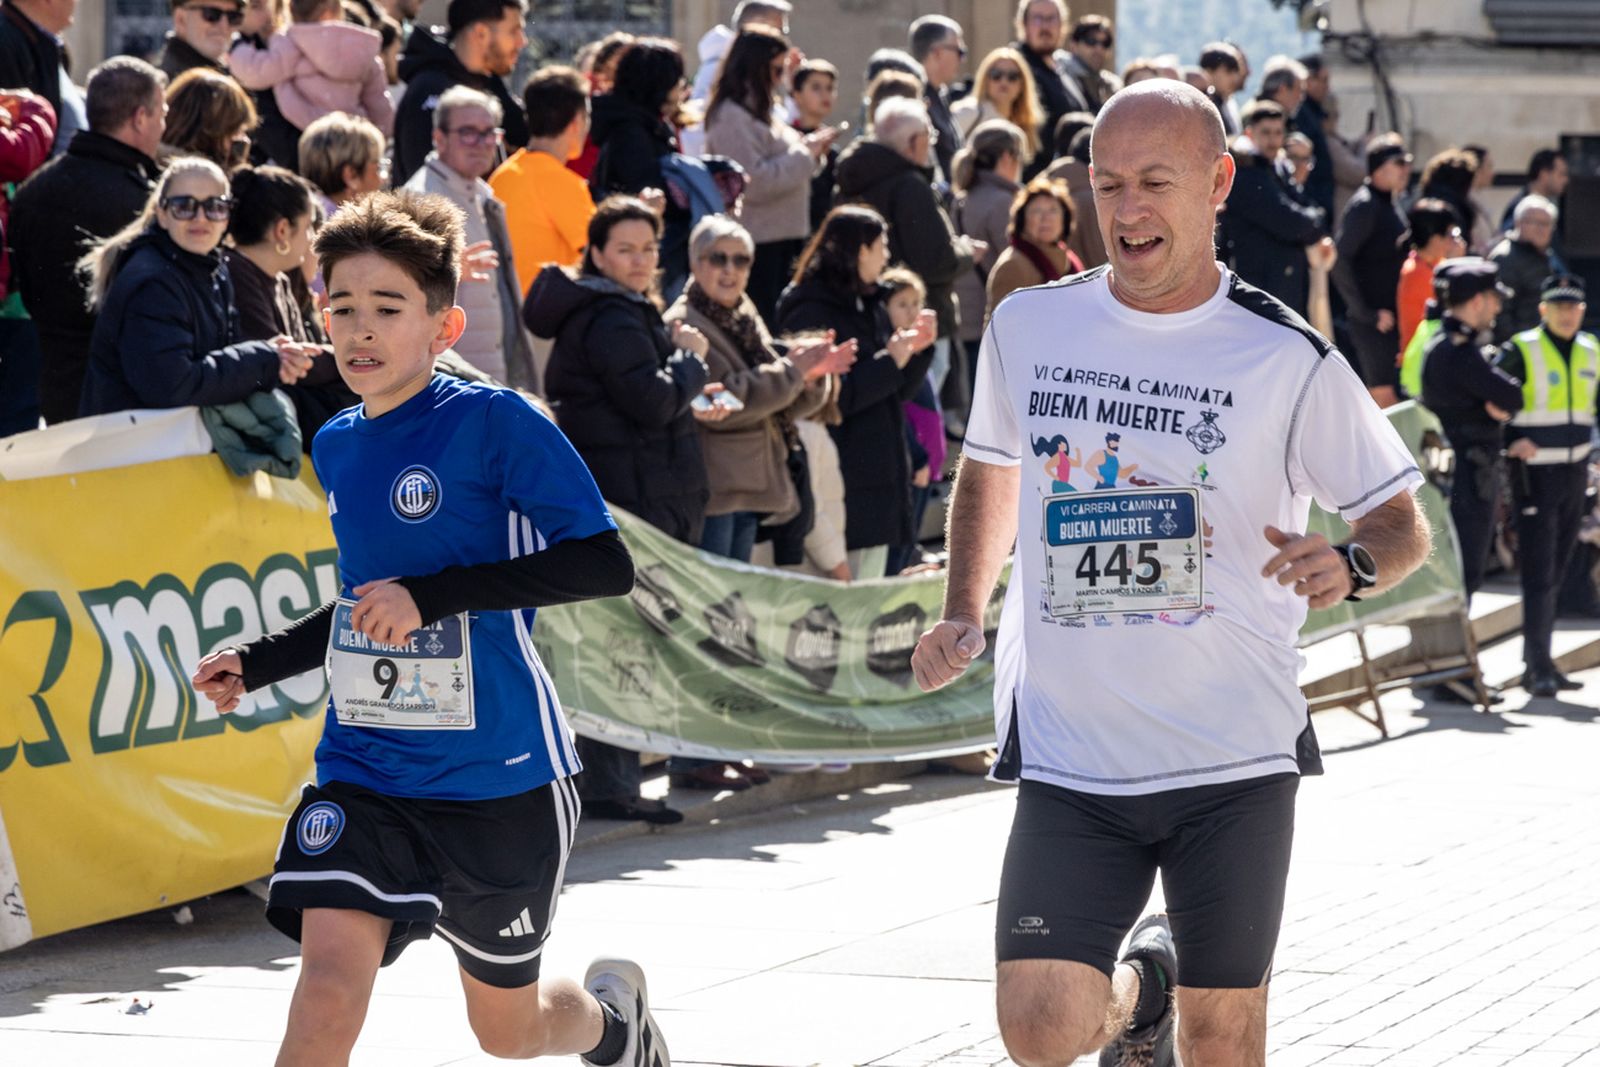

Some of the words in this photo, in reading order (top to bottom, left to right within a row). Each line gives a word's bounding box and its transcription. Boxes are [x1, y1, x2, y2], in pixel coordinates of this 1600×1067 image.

[1034, 364, 1048, 380] VI
[1052, 366, 1131, 392] CARRERA
[1137, 379, 1234, 407] CAMINATA
[1028, 391, 1088, 420] BUENA
[1096, 398, 1186, 435] MUERTE
[1060, 506, 1070, 517] VI
[1071, 502, 1118, 515] CARRERA
[1120, 499, 1178, 512] CAMINATA
[1060, 519, 1097, 540] BUENA
[1100, 517, 1152, 537] MUERTE
[1075, 542, 1162, 587] 445
[373, 658, 399, 699] 9
